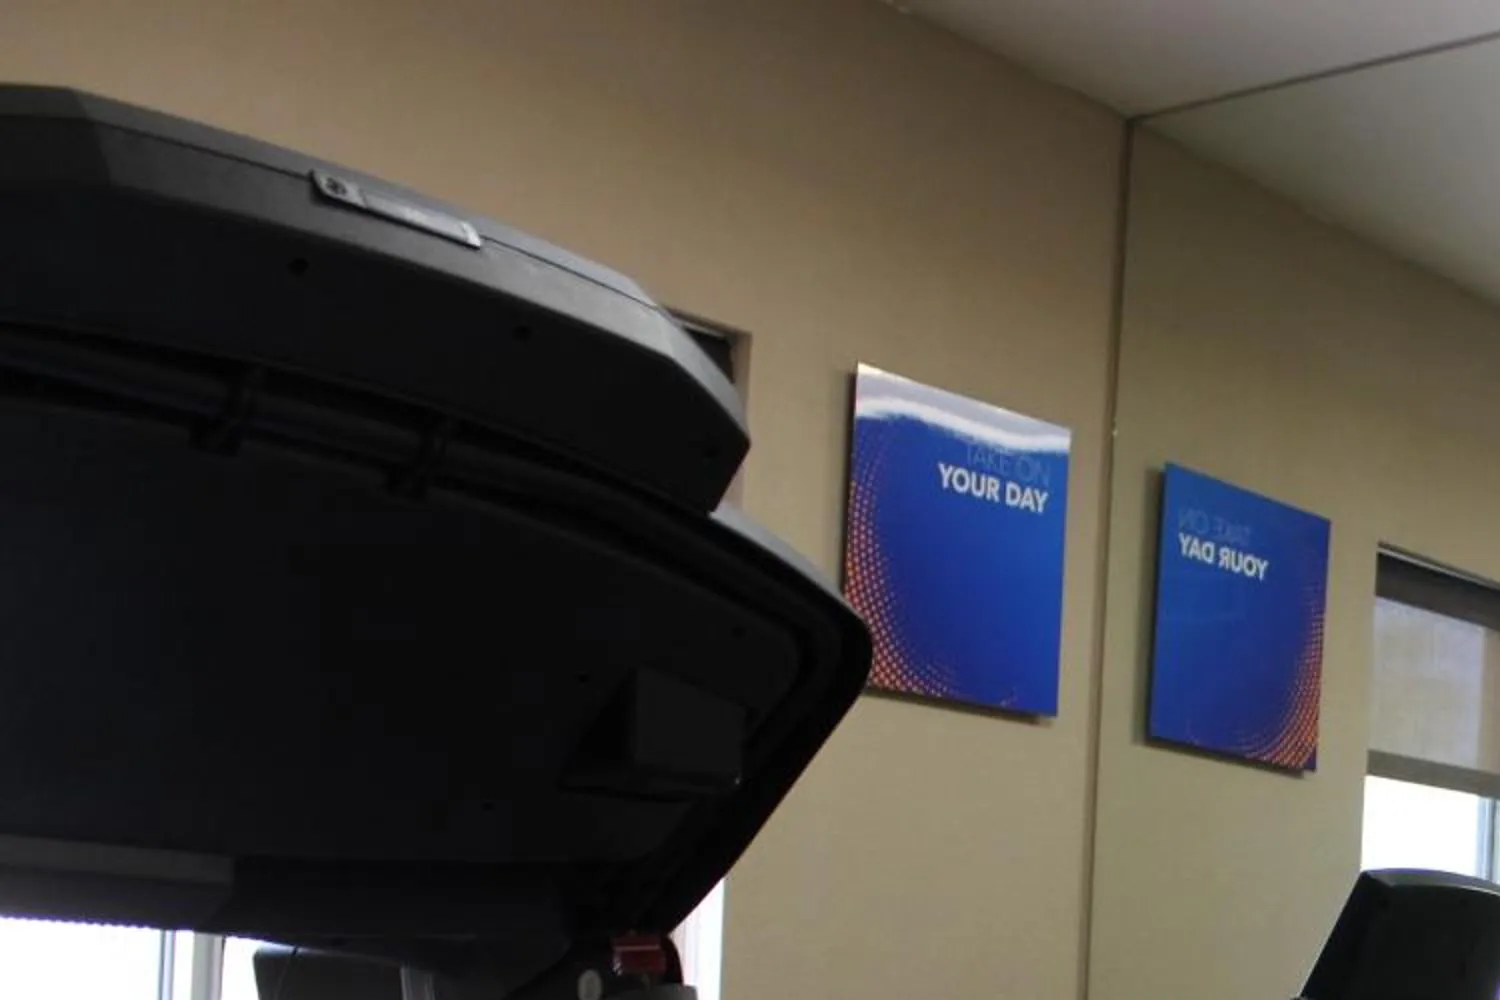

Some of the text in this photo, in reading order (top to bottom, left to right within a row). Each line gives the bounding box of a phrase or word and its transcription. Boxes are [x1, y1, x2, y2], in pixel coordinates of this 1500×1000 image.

[937, 460, 1048, 514] YOUR DAY
[1014, 455, 1051, 488] ON
